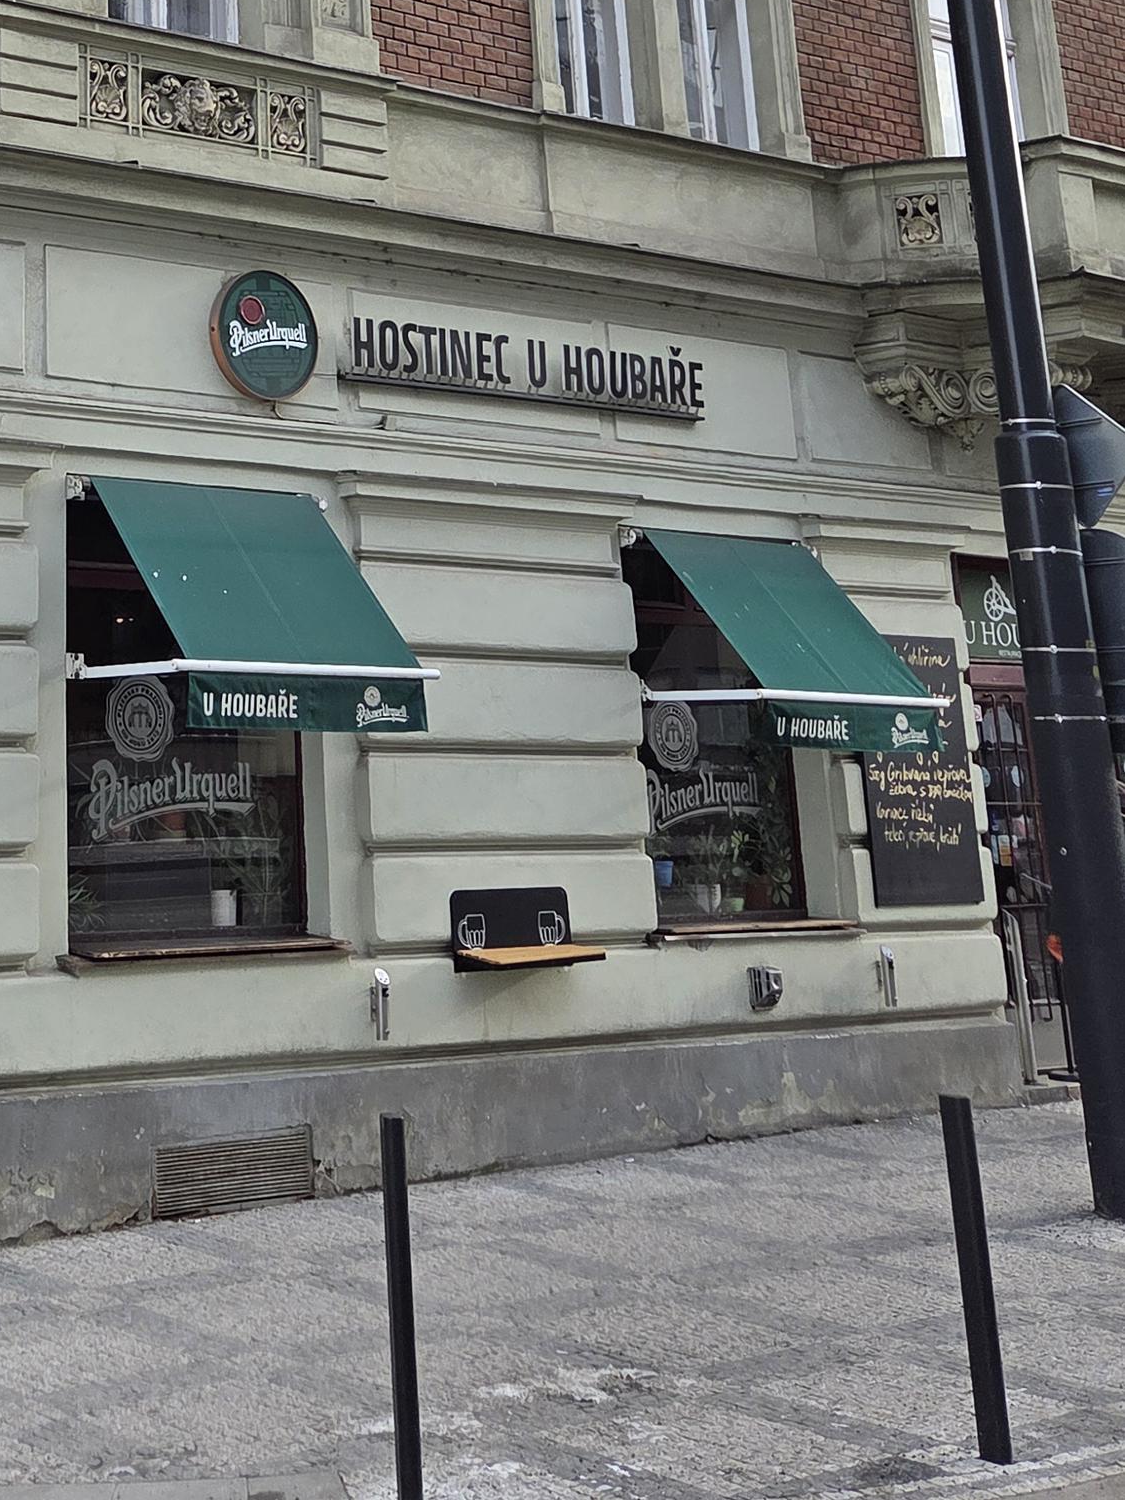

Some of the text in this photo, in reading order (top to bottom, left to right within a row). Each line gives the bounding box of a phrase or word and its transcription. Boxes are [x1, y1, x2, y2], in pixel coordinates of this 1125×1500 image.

[229, 318, 307, 357] Pilsner Urquell
[353, 316, 705, 408] HOSTINEC U HOUBAŘE
[203, 688, 299, 719] U HOUBAŘE
[777, 714, 850, 741] U HOUBAŘE
[88, 757, 252, 842] Pilsner Urquell
[647, 766, 759, 837] Pilsner Urquell
